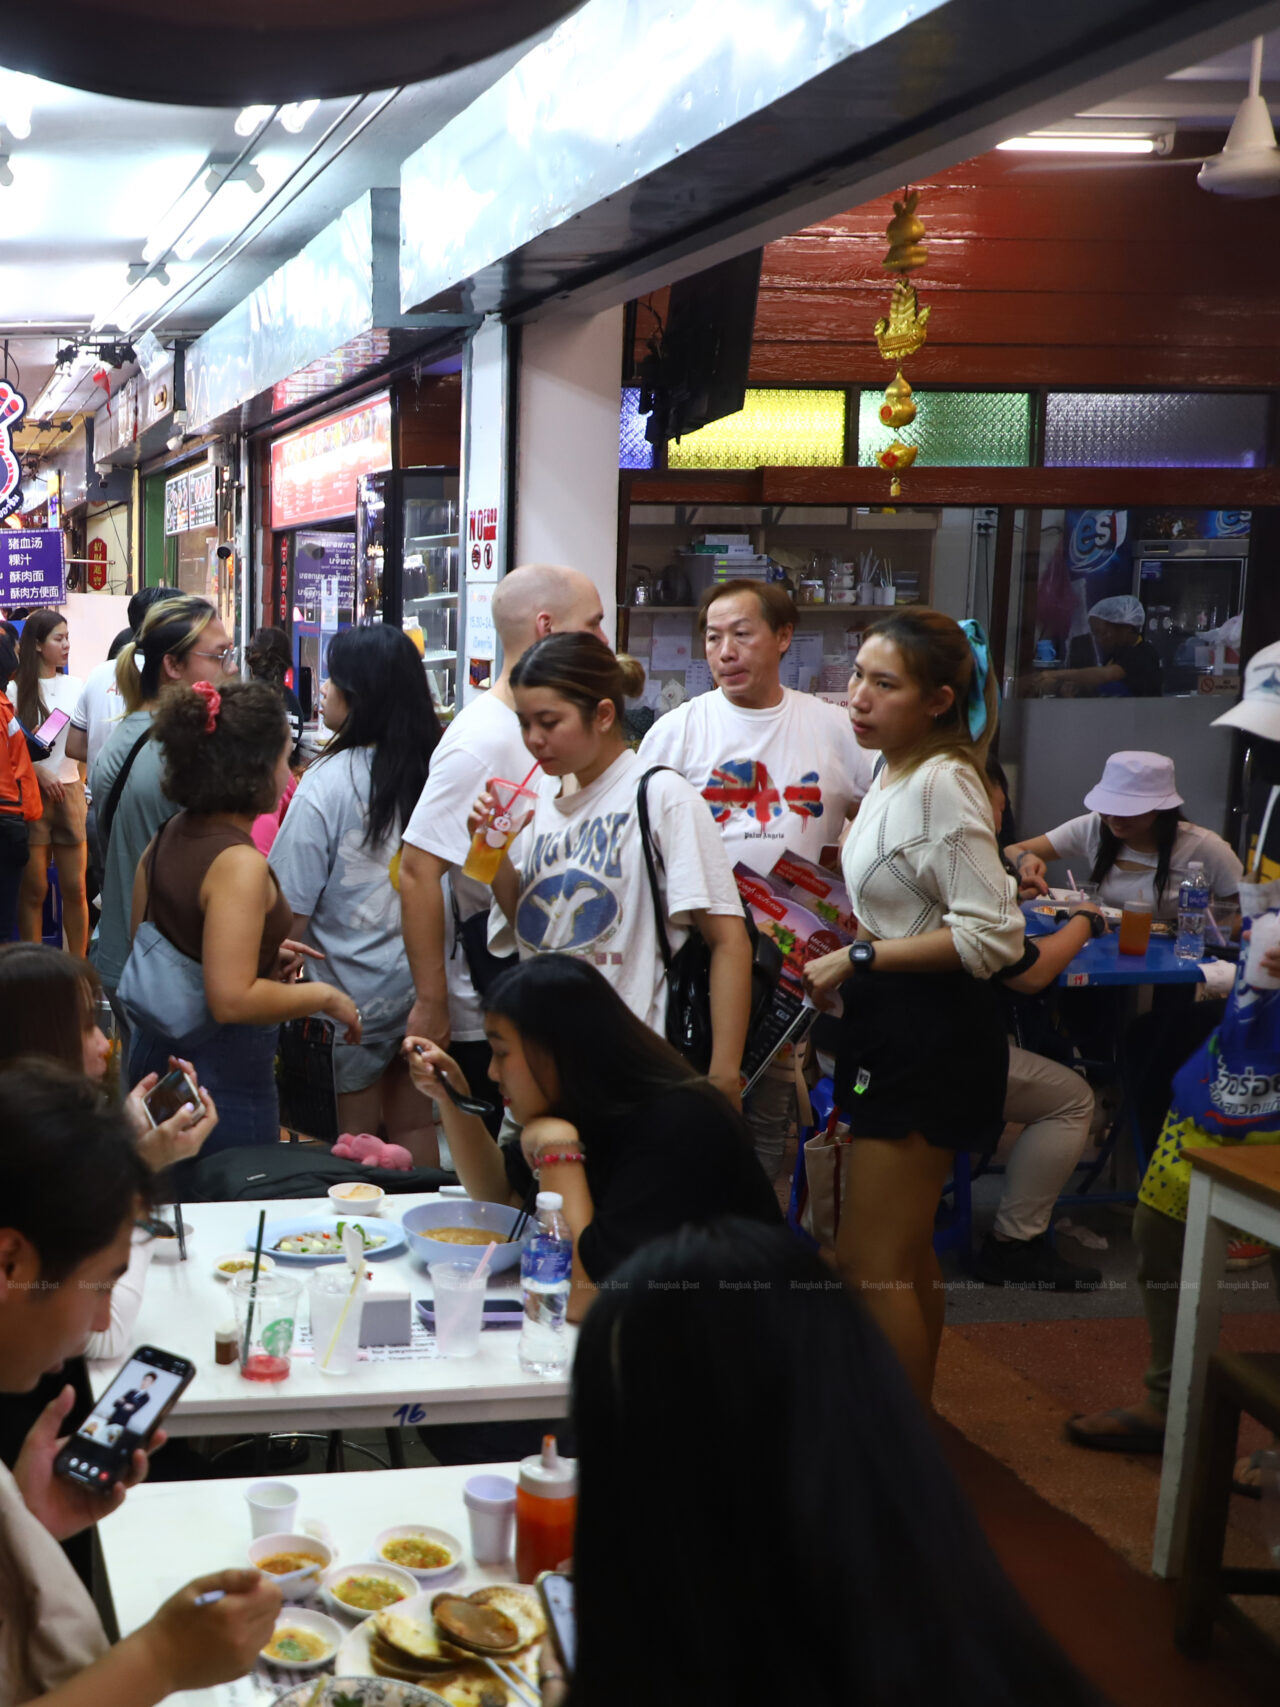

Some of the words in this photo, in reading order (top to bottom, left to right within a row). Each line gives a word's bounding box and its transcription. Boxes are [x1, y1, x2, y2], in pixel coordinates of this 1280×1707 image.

[469, 509, 483, 541] NO
[8, 537, 43, 549] 猪血汤
[9, 570, 44, 583] 酥肉面
[10, 585, 59, 600] 酥肉方便面
[392, 1402, 426, 1428] 16
